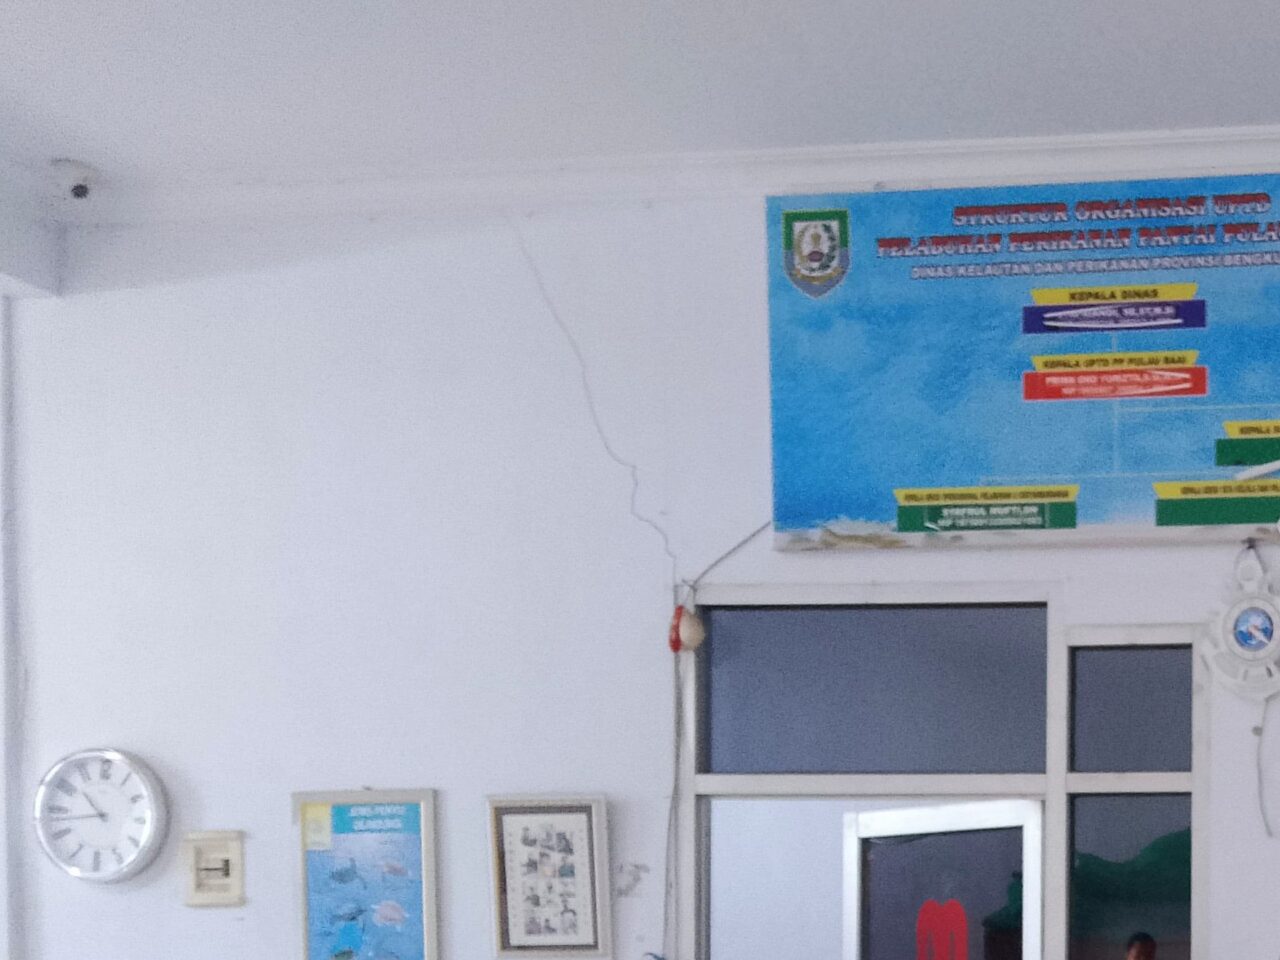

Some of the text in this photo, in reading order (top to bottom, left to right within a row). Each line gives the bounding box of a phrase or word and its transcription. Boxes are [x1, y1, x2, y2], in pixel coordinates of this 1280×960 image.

[953, 192, 1272, 227] STRUKTUR ORGANISASI UPTD
[876, 233, 1003, 258] PELABUHAN
[1008, 228, 1131, 252] PERIKANAN
[1137, 224, 1217, 248] PANTAI
[911, 264, 952, 280] DINAS
[957, 261, 1032, 278] KELAUTAN
[1034, 260, 1065, 275] DAN
[1066, 256, 1149, 274] PERIKANAN
[1151, 253, 1218, 271] PROVINSI
